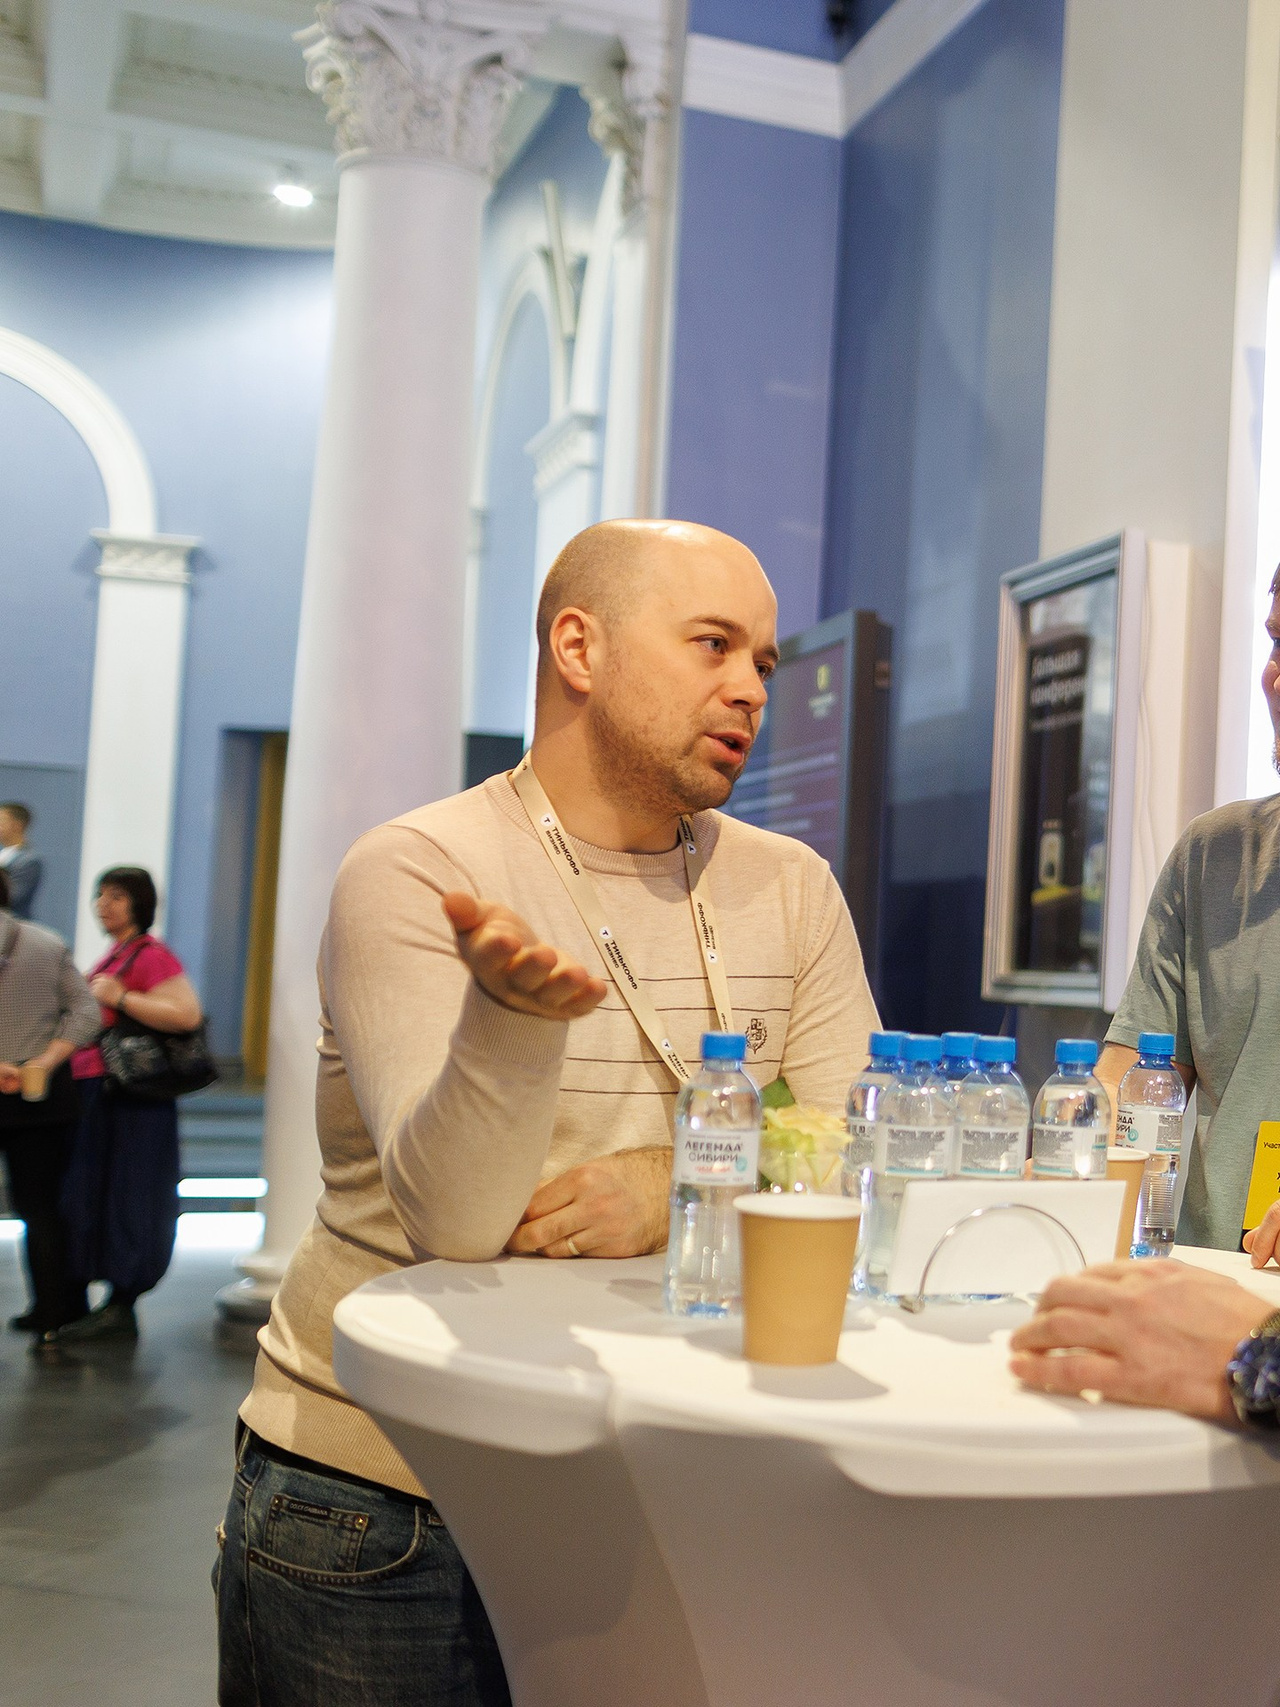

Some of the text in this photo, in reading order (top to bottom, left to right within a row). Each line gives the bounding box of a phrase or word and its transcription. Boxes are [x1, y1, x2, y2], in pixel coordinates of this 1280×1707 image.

[552, 826, 580, 876] ТИНЬКОФФ
[610, 939, 638, 990] ТИНЬКОФФ
[688, 1153, 738, 1163] СИБИРИ
